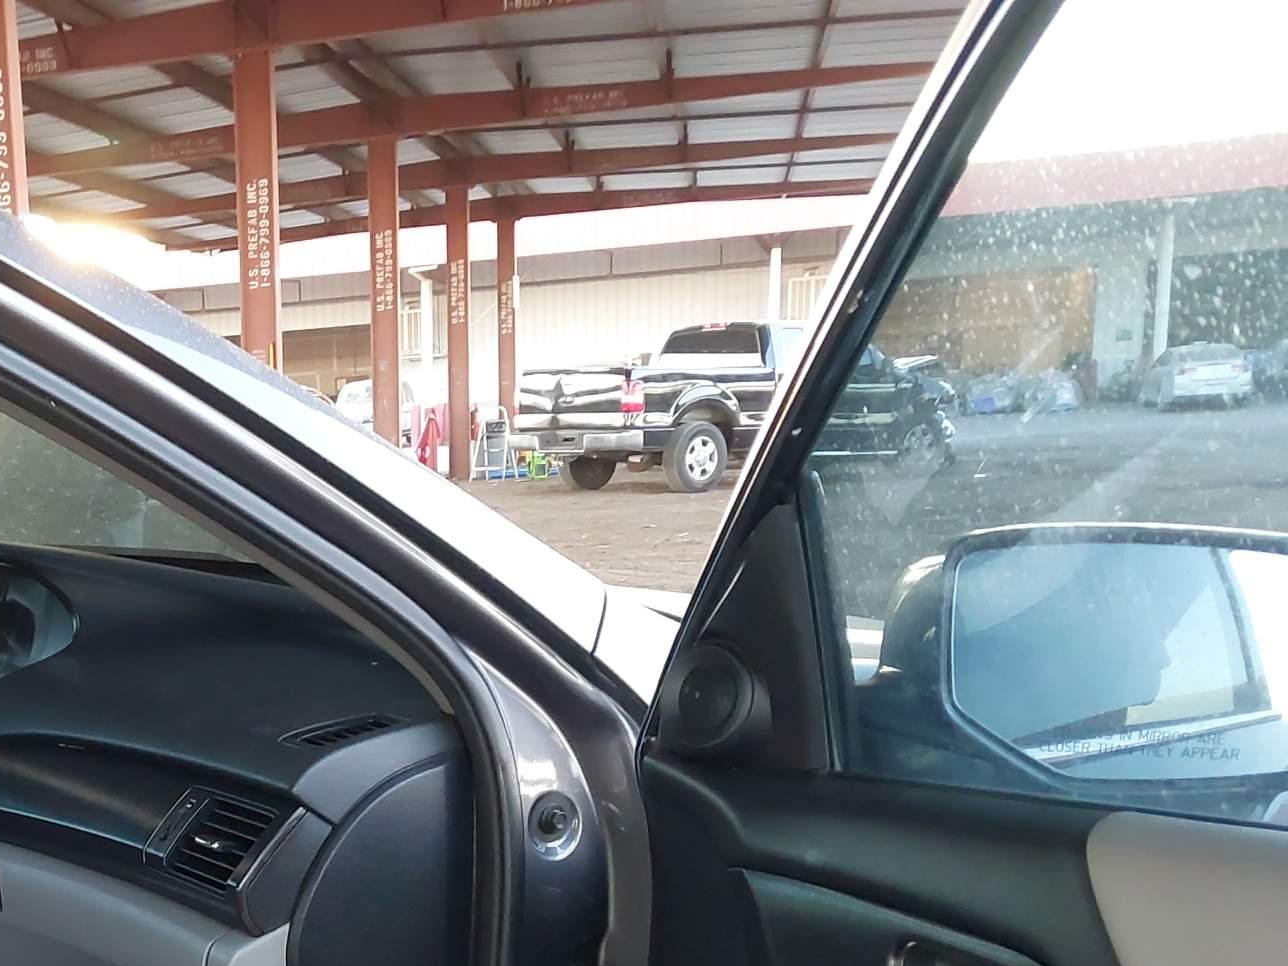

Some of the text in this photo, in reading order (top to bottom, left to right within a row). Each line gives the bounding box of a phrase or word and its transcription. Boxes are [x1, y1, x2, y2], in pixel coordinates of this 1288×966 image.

[247, 209, 258, 259] PREFAB
[258, 178, 271, 288] 1-866-799-0969
[248, 264, 259, 290] U.S.
[1180, 747, 1241, 761] APPEAR
